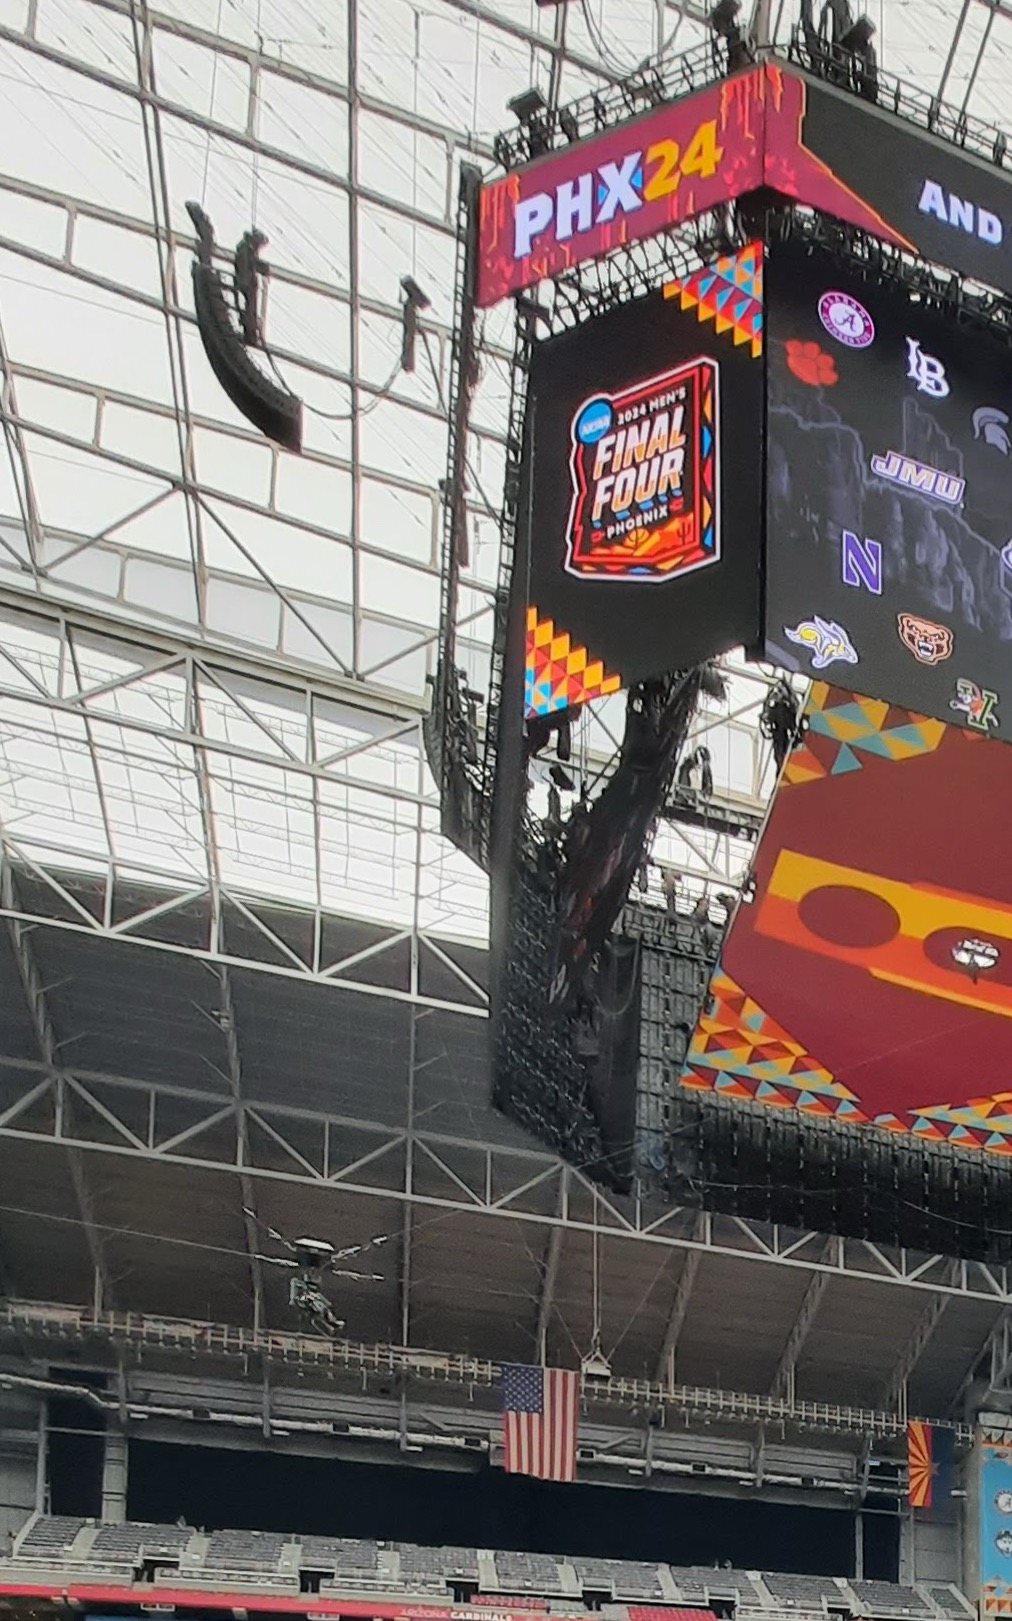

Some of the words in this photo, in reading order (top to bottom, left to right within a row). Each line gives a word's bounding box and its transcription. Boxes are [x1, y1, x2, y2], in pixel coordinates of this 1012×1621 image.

[514, 119, 722, 258] PHX24
[918, 179, 1003, 246] AND
[617, 406, 647, 425] 2024
[650, 386, 687, 412] MEN'S
[593, 405, 686, 480] FINAL
[592, 448, 685, 521] FOUR
[873, 453, 963, 504] JMU
[606, 506, 669, 539] PHOENIX
[842, 530, 882, 595] N
[450, 1611, 513, 1621] CARDINALS
